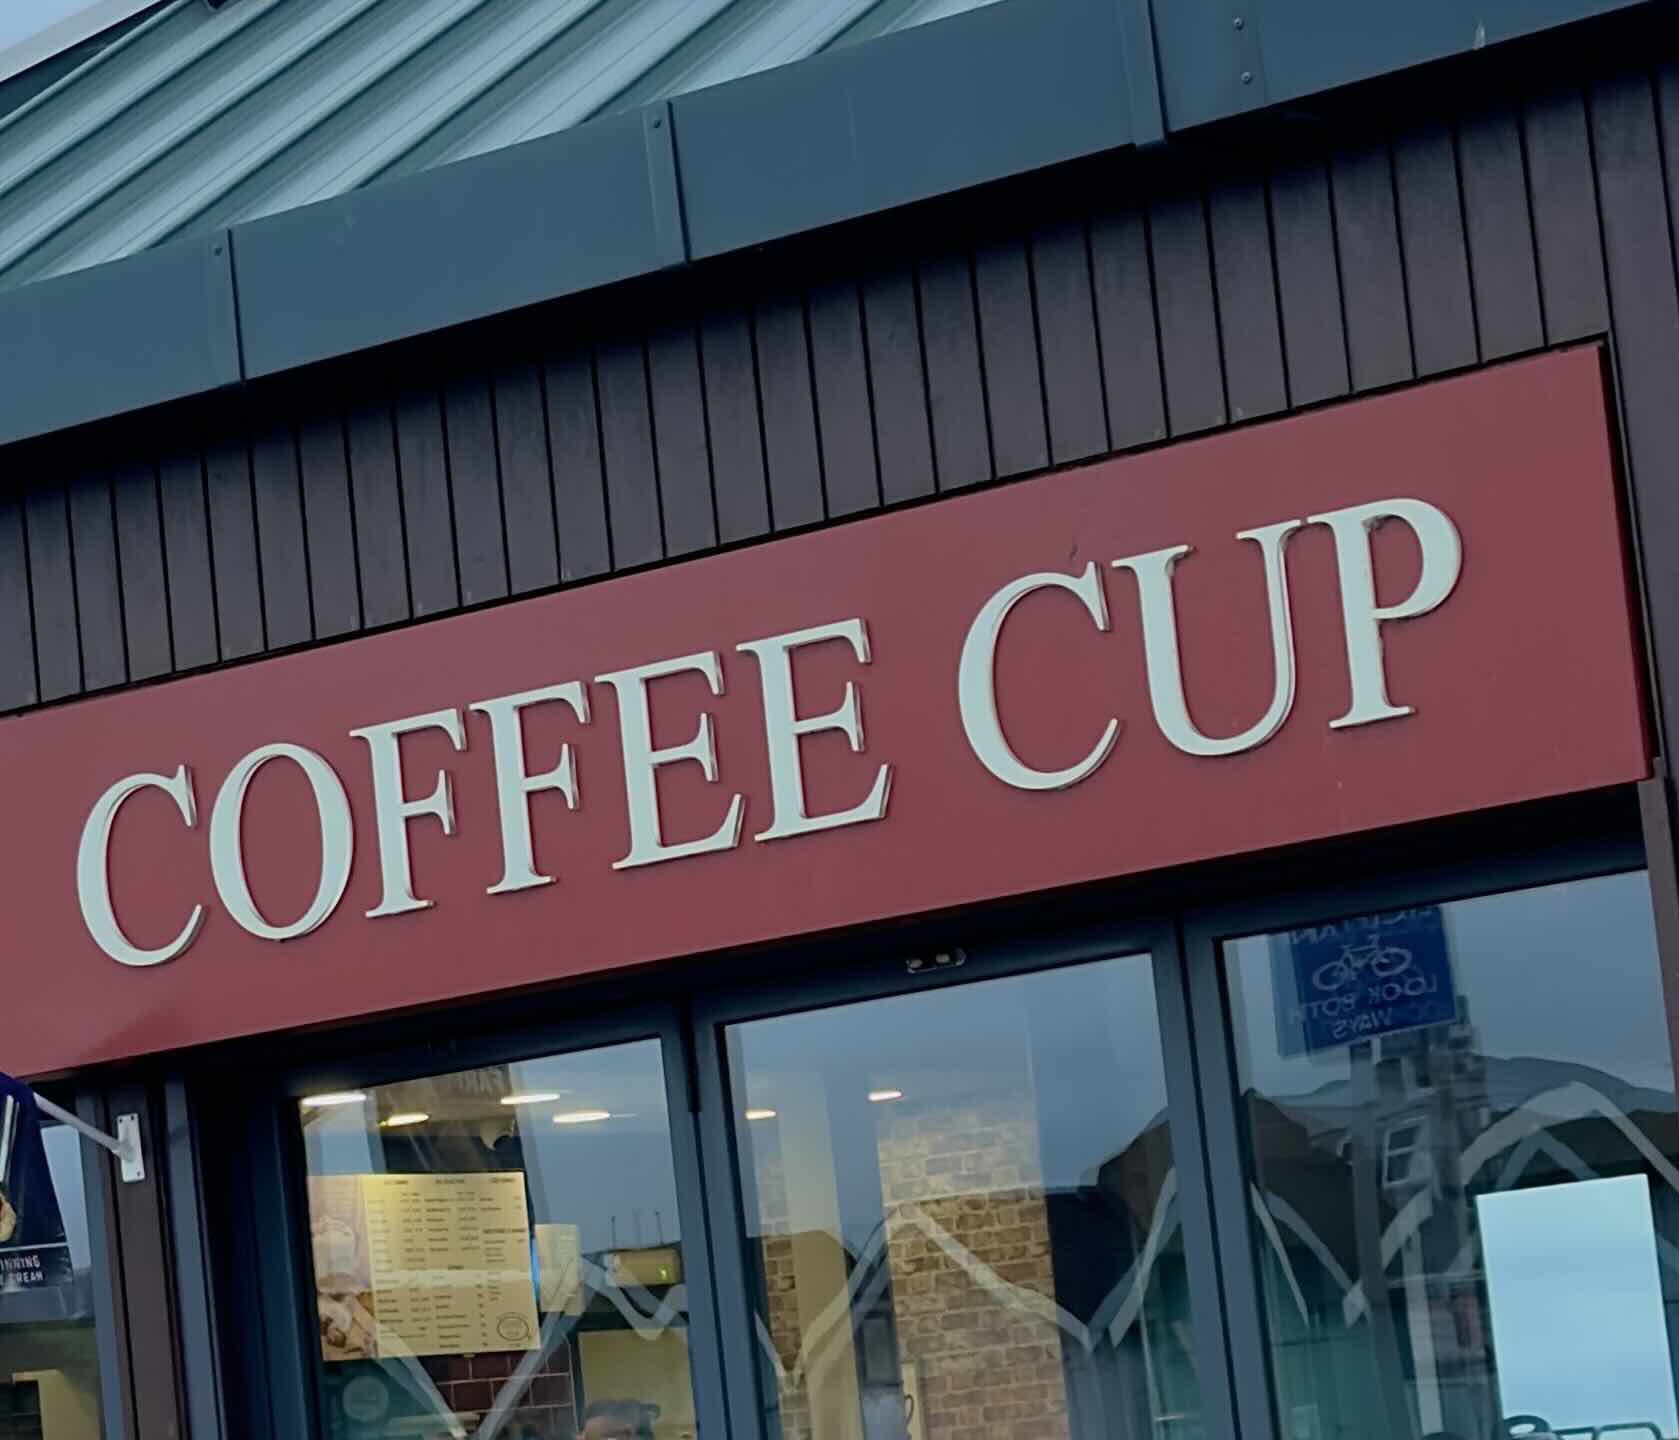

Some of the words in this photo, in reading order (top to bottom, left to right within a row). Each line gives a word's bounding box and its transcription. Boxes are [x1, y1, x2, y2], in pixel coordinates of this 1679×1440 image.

[72, 616, 895, 969] COFFEE
[953, 495, 1464, 793] CUP
[6, 1270, 44, 1286] REAM
